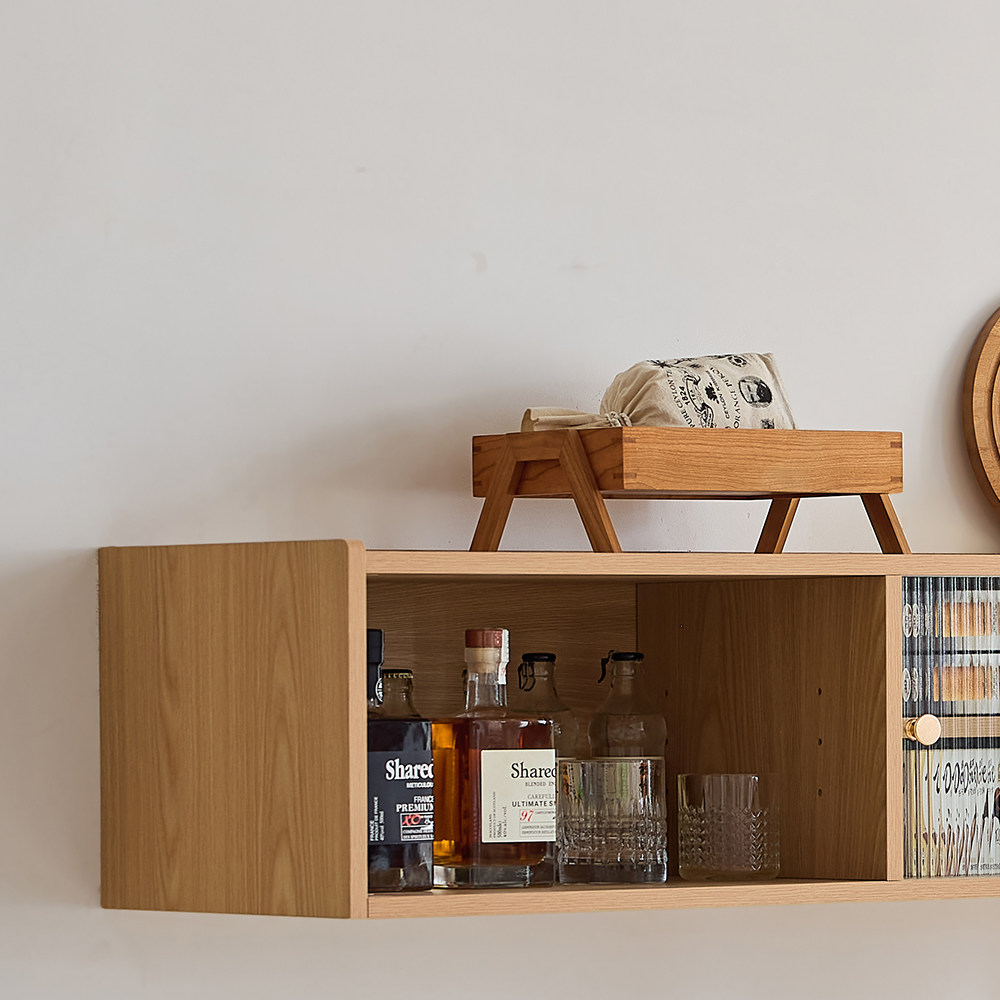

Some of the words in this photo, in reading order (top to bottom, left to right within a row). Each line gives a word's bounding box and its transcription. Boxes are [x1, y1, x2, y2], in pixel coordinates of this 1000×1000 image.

[667, 379, 683, 409] CEYLON
[679, 385, 690, 405] 1824
[718, 393, 730, 419] CEYLON
[729, 389, 741, 428] ORANGE
[681, 409, 695, 428] PURE
[520, 810, 534, 822] 97
